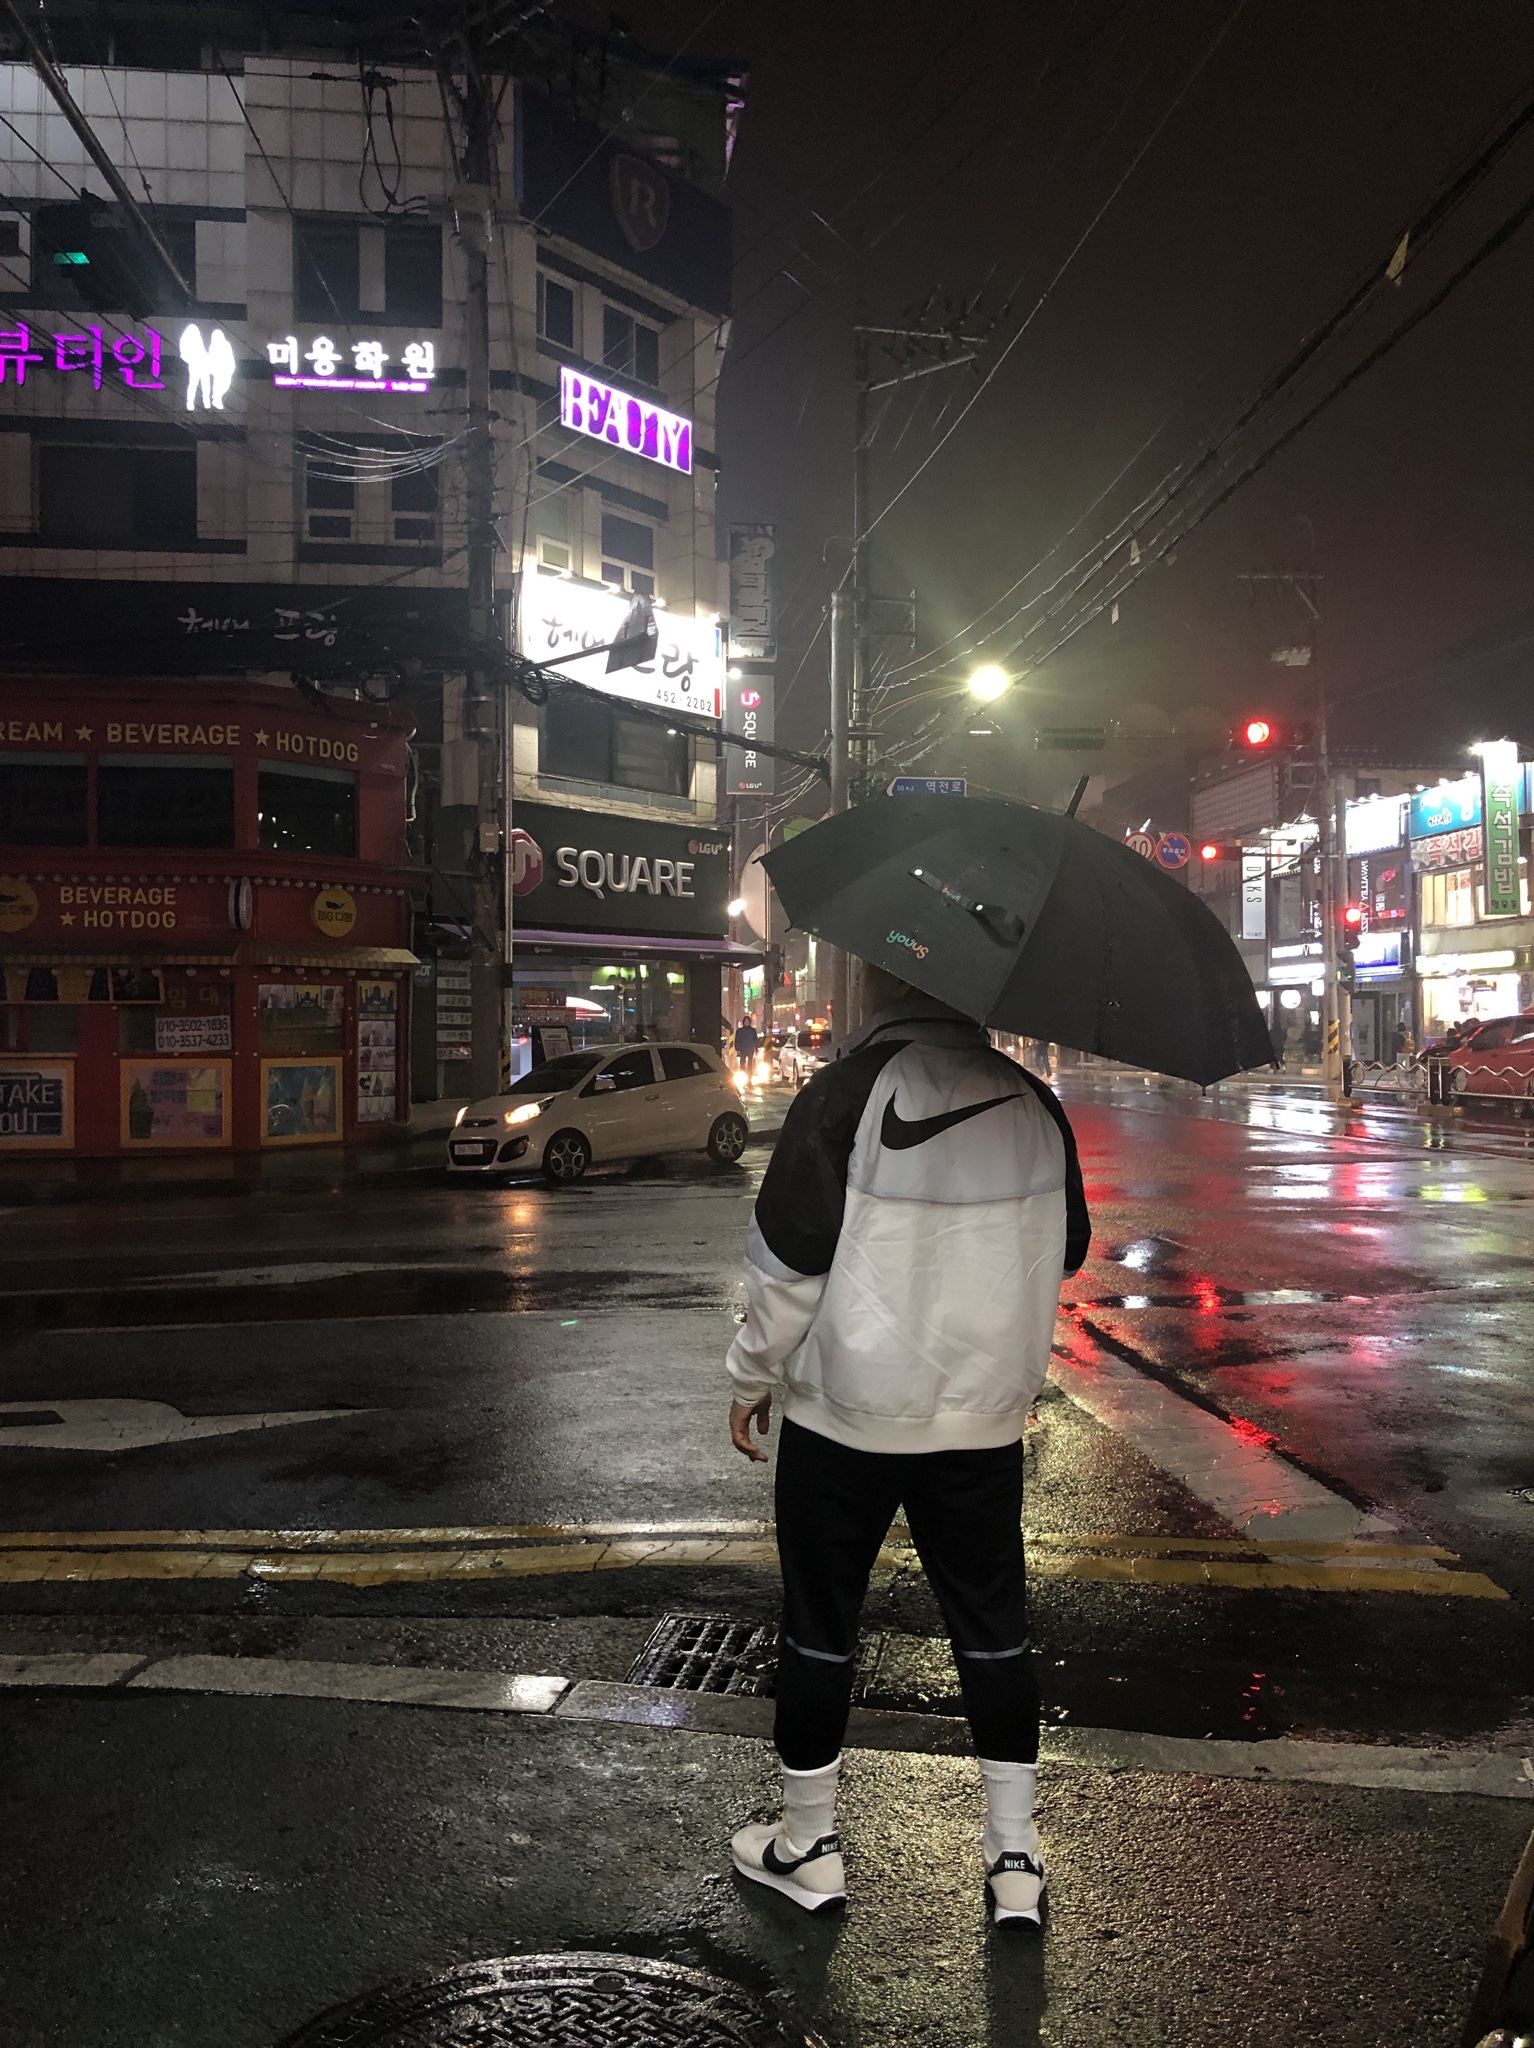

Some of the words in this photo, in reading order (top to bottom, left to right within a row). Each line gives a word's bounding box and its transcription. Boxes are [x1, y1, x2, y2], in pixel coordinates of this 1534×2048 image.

[561, 368, 692, 474] BEAUTY
[107, 723, 241, 746] BEVERAGE
[276, 731, 359, 763] HOTDOG
[743, 711, 758, 769] SQURE
[925, 781, 962, 794] 역전로
[1491, 782, 1516, 894] 즉석김밥
[1130, 840, 1149, 858] 40
[556, 846, 695, 899] SQUARE
[60, 887, 177, 905] BEVERAGE
[84, 911, 177, 929] HOTDOG
[158, 1033, 230, 1048] 010-3537-4233
[821, 1841, 838, 1853] NIKE
[1004, 1859, 1026, 1870] NIKE
